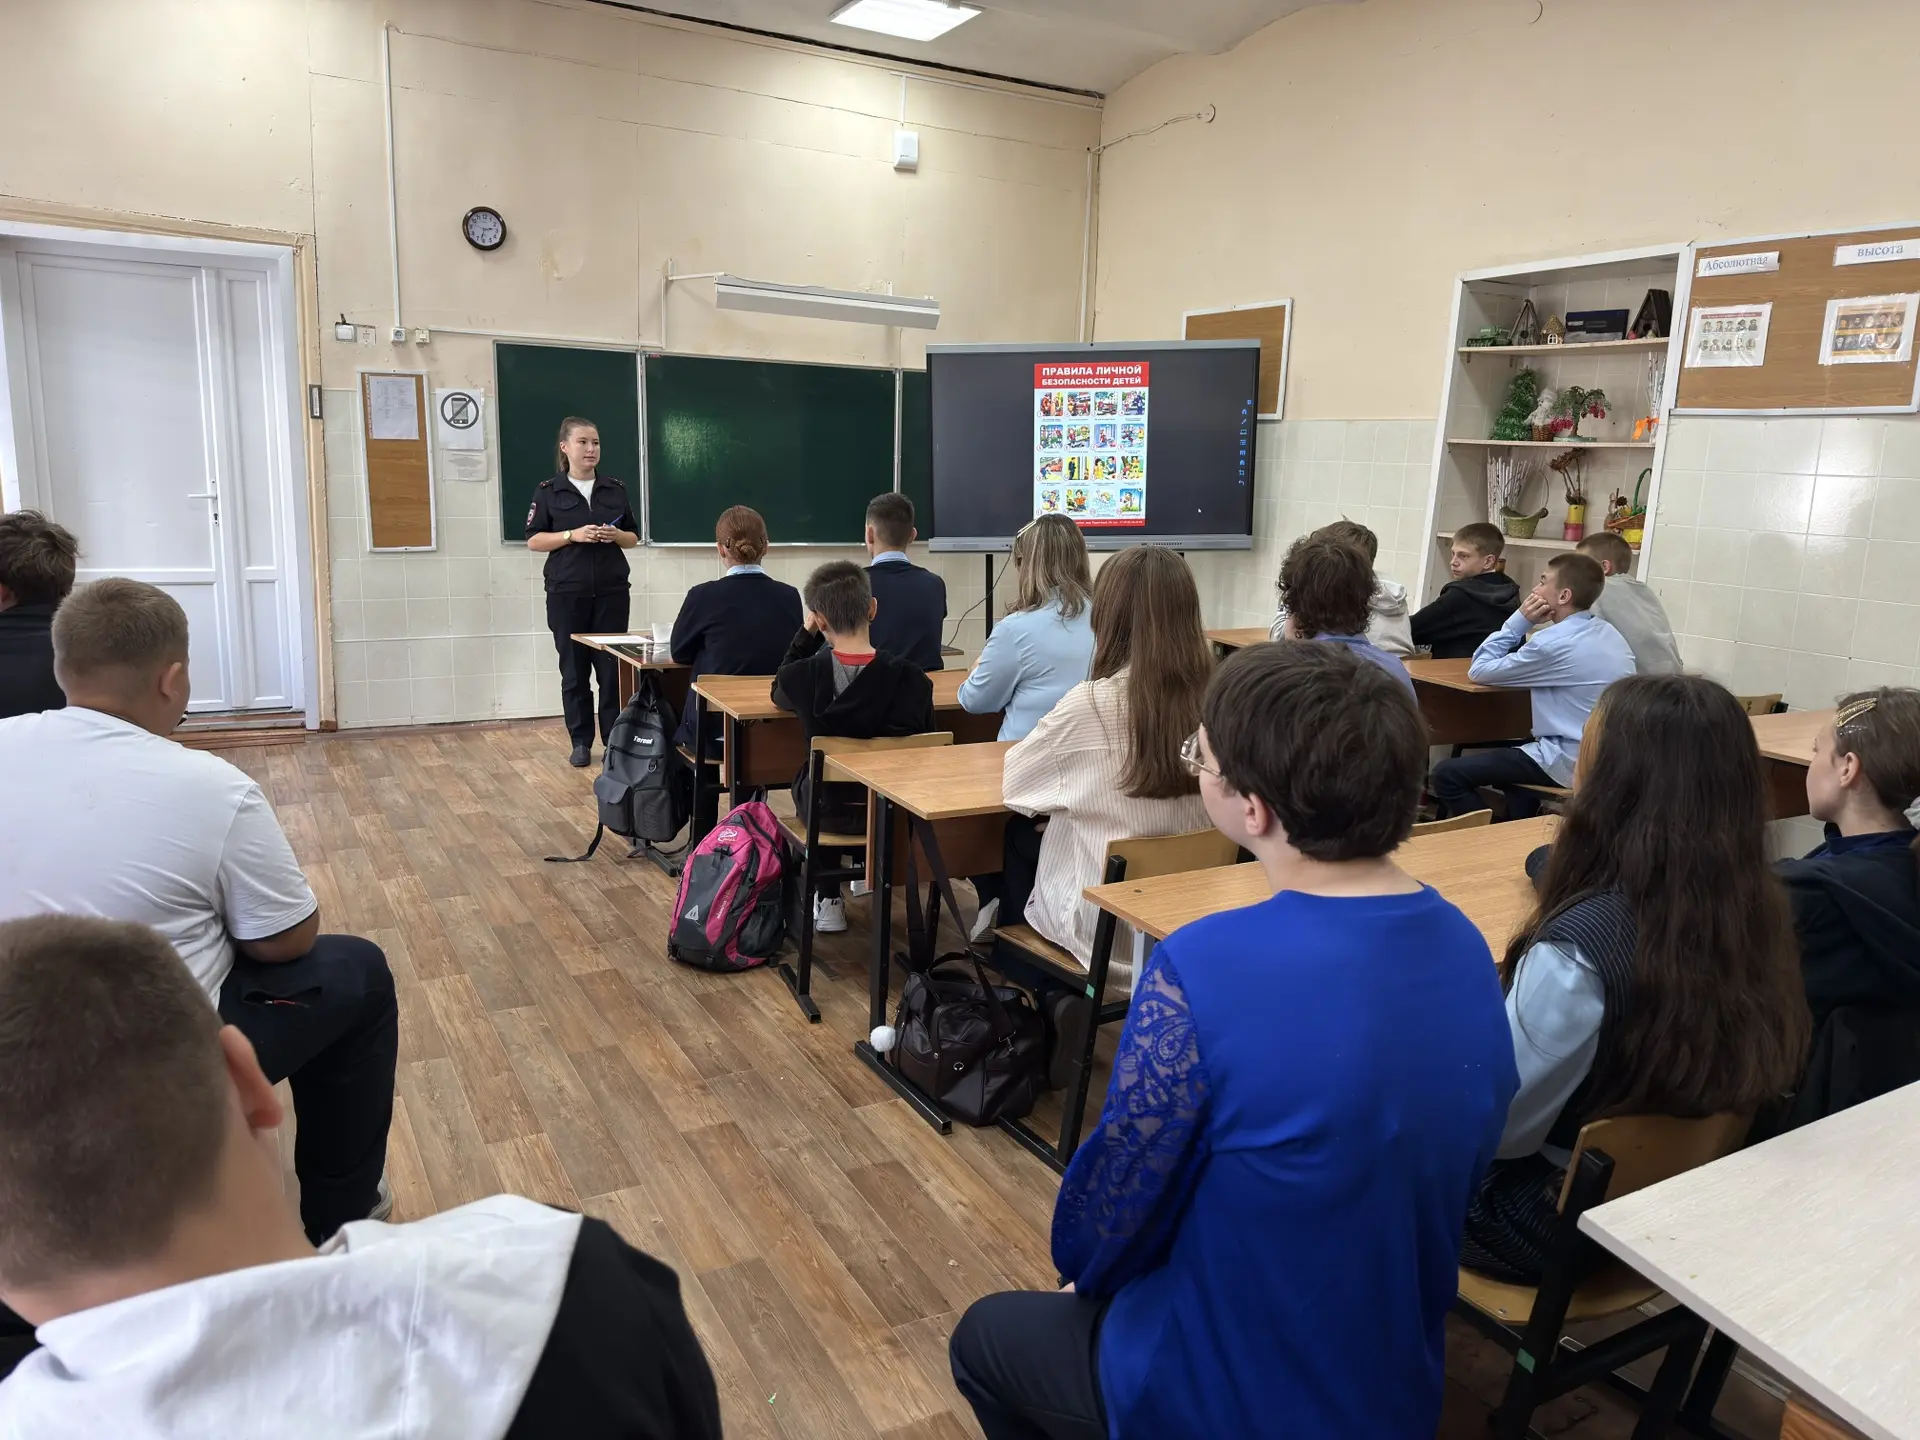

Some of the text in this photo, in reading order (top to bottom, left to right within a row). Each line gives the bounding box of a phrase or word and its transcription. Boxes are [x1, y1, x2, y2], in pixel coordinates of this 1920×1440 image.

[1857, 244, 1904, 257] высота
[1703, 256, 1768, 272] Абсолютная
[1042, 364, 1142, 376] ПРАВИЛА ЛИЧНОЙ
[1042, 376, 1141, 386] БЕЗОПАСНОСТИ ДЕТЕЙ
